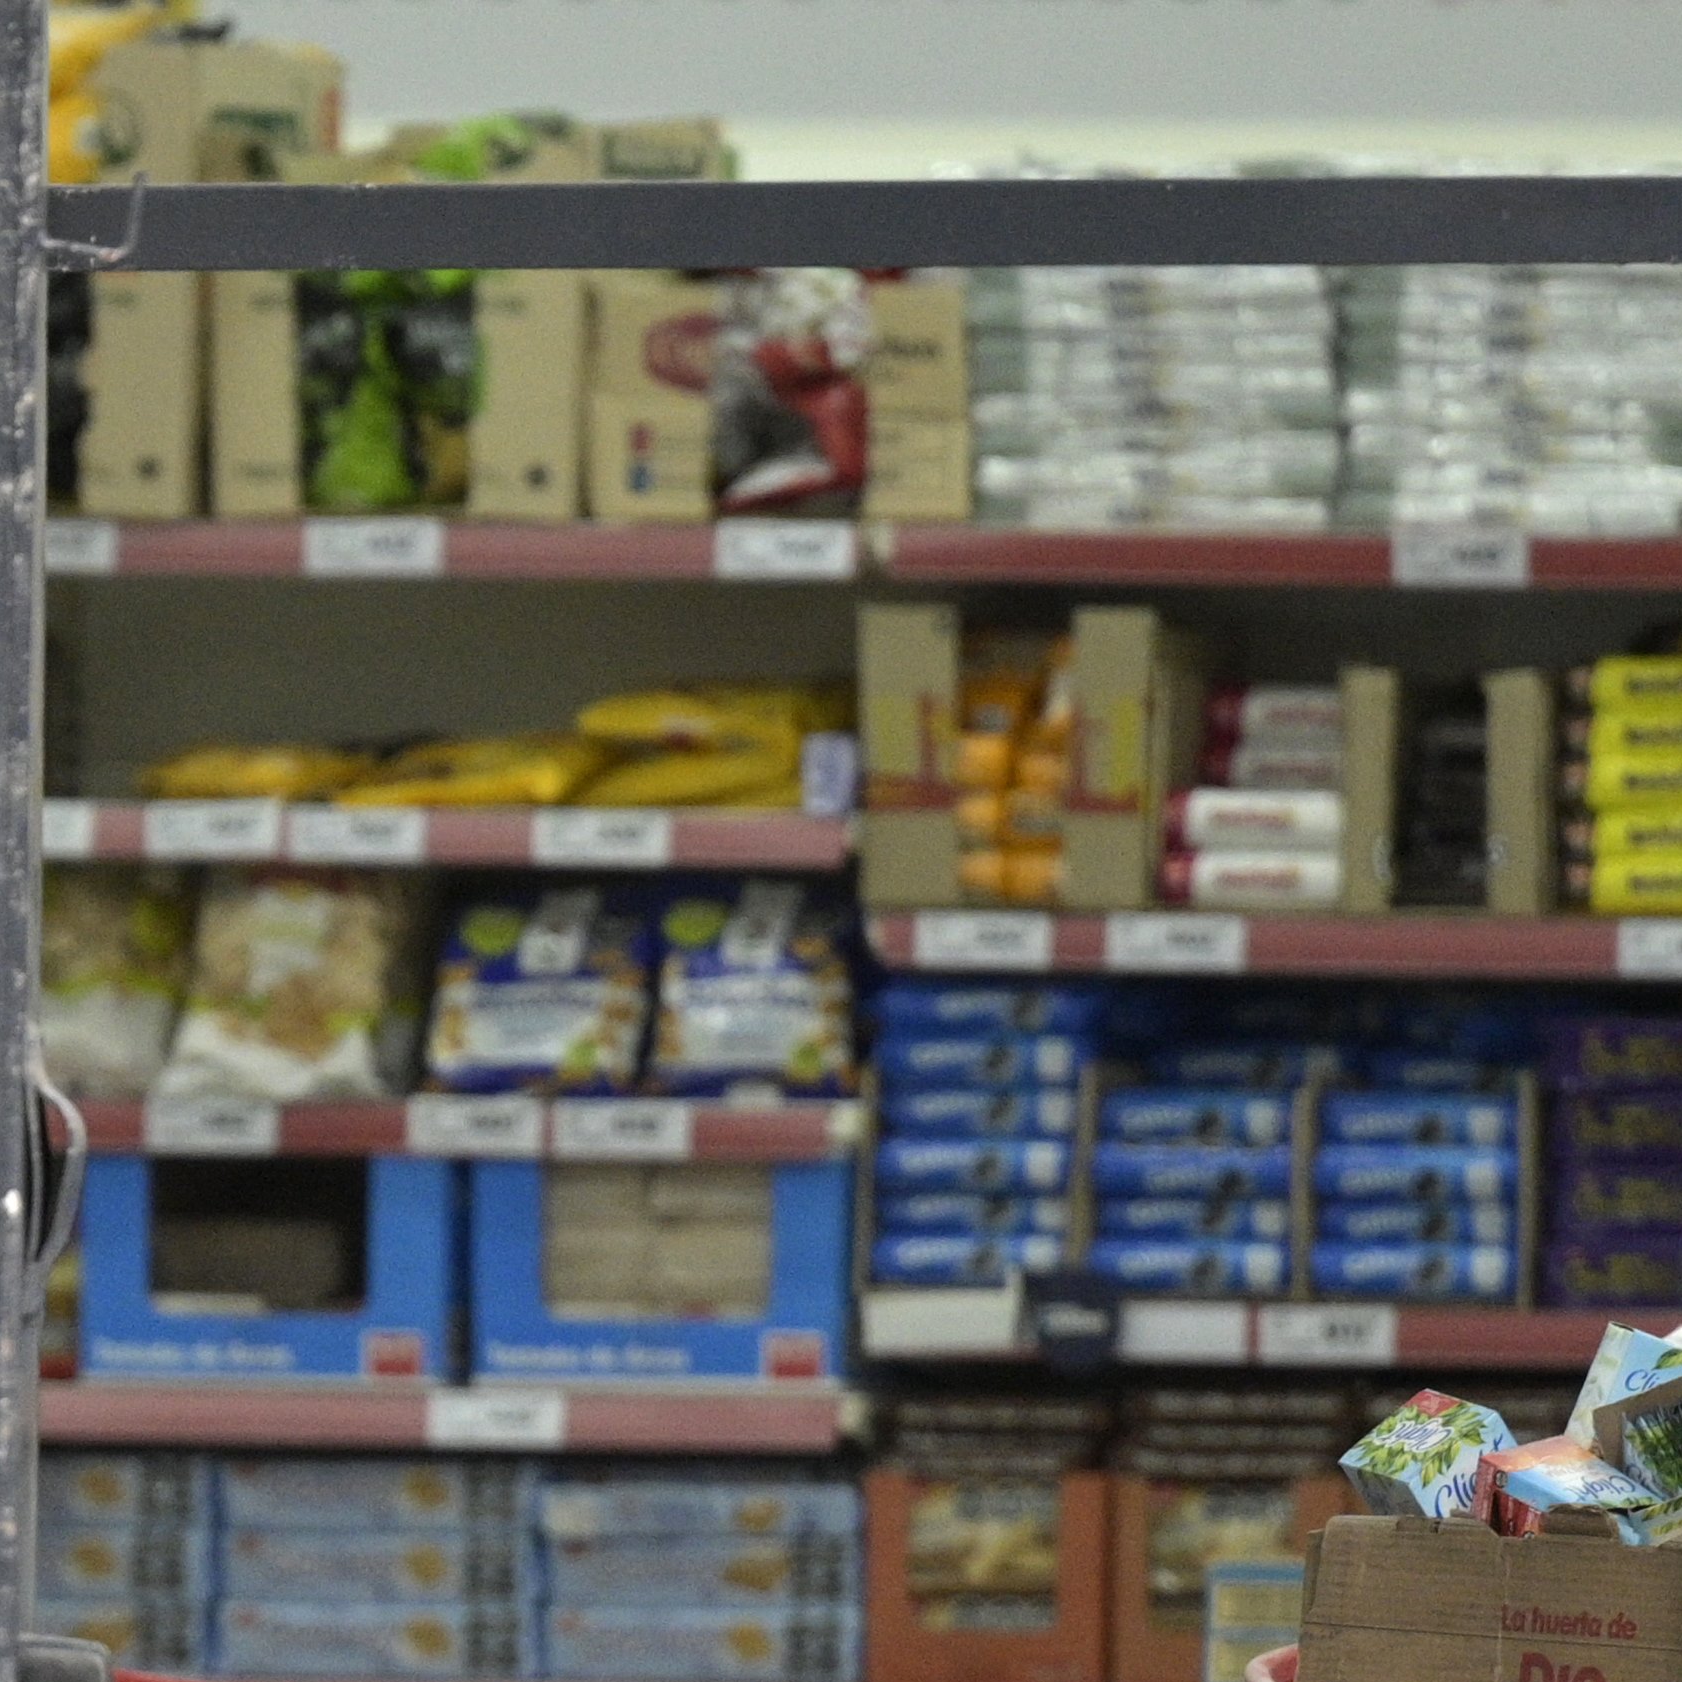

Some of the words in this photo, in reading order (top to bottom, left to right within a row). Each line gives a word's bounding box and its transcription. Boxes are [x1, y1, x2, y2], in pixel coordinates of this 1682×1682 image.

[1501, 1603, 1526, 1632] La
[1531, 1606, 1602, 1637] huerta
[1608, 1612, 1638, 1640] de
